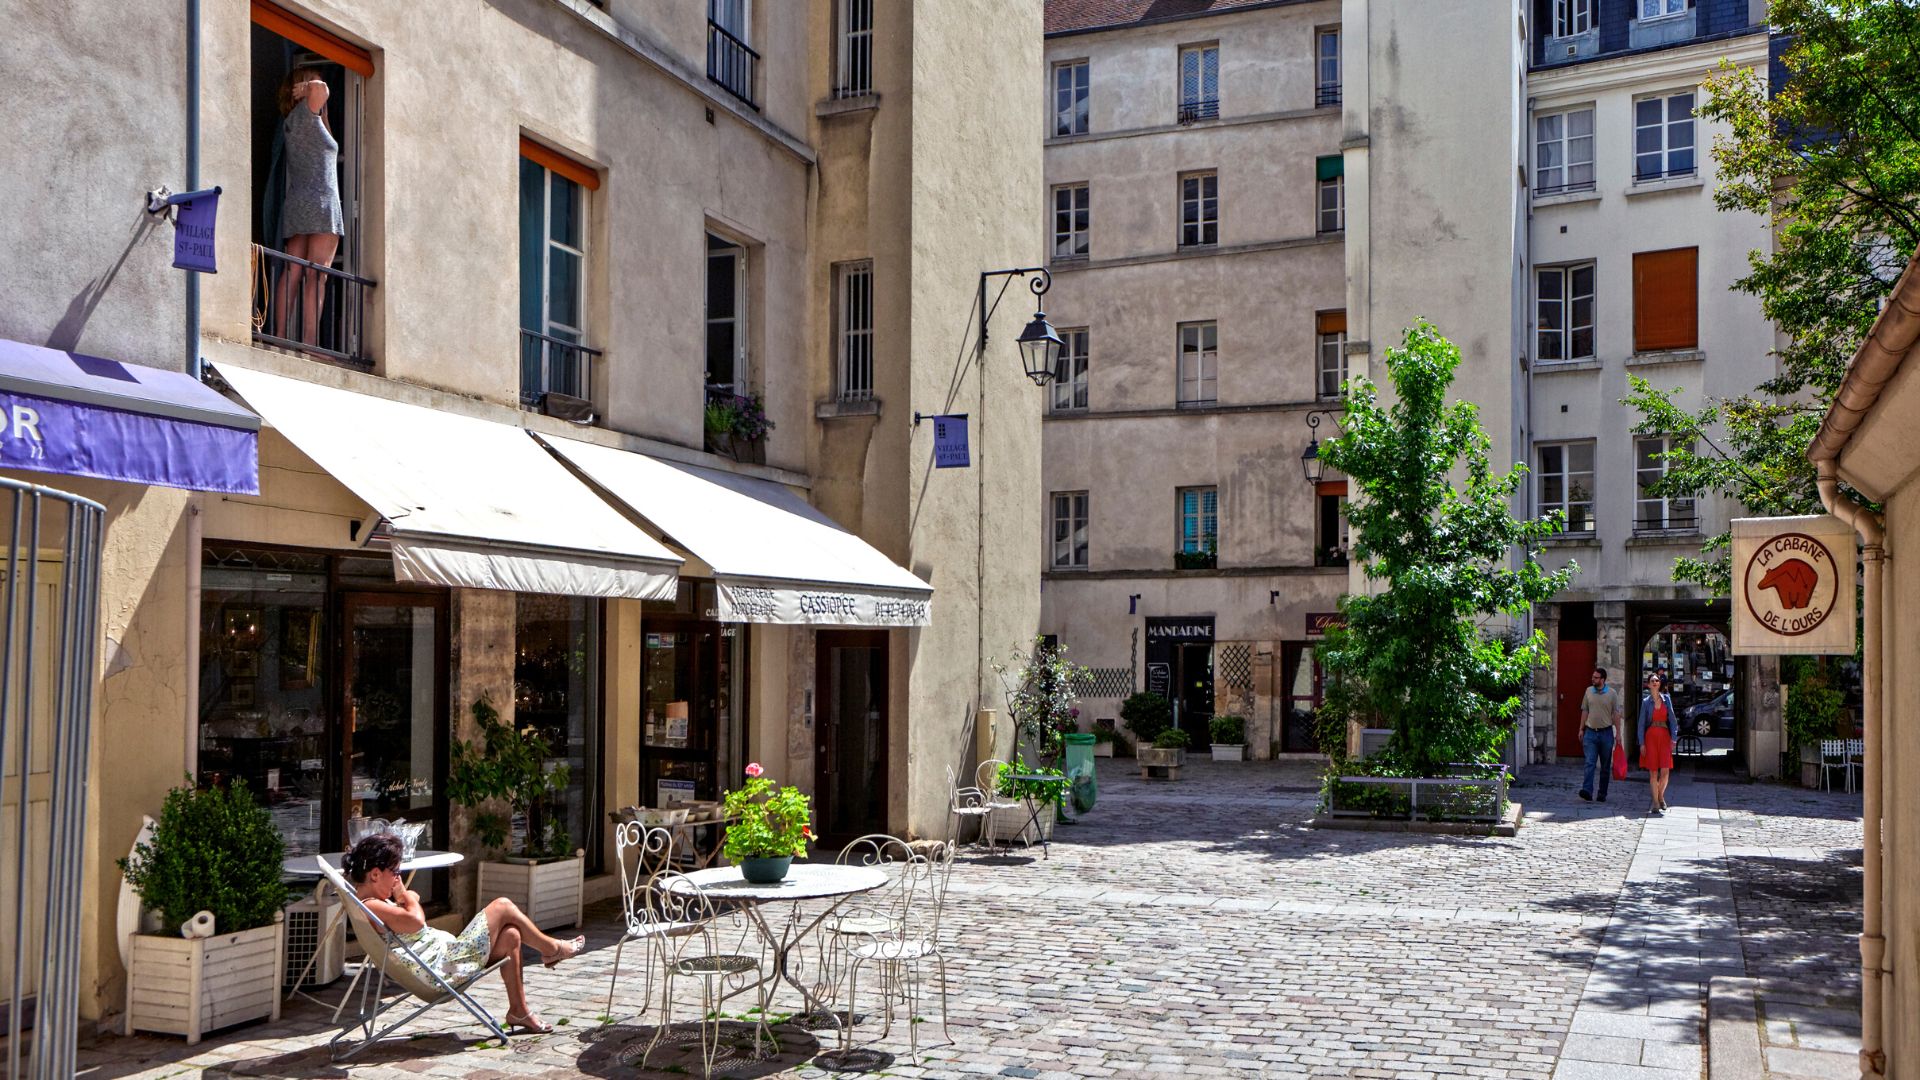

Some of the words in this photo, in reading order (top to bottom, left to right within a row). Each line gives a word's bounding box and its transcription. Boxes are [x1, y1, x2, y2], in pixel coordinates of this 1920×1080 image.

[180, 224, 215, 240] VILLAGE
[179, 241, 214, 257] ST-PAUL
[0, 404, 42, 440] R
[1757, 549, 1774, 567] LA
[1774, 537, 1825, 563] CABANE
[1763, 610, 1780, 628] DE
[1781, 607, 1823, 631] L'OURS
[1148, 625, 1212, 637] MANDARINE
